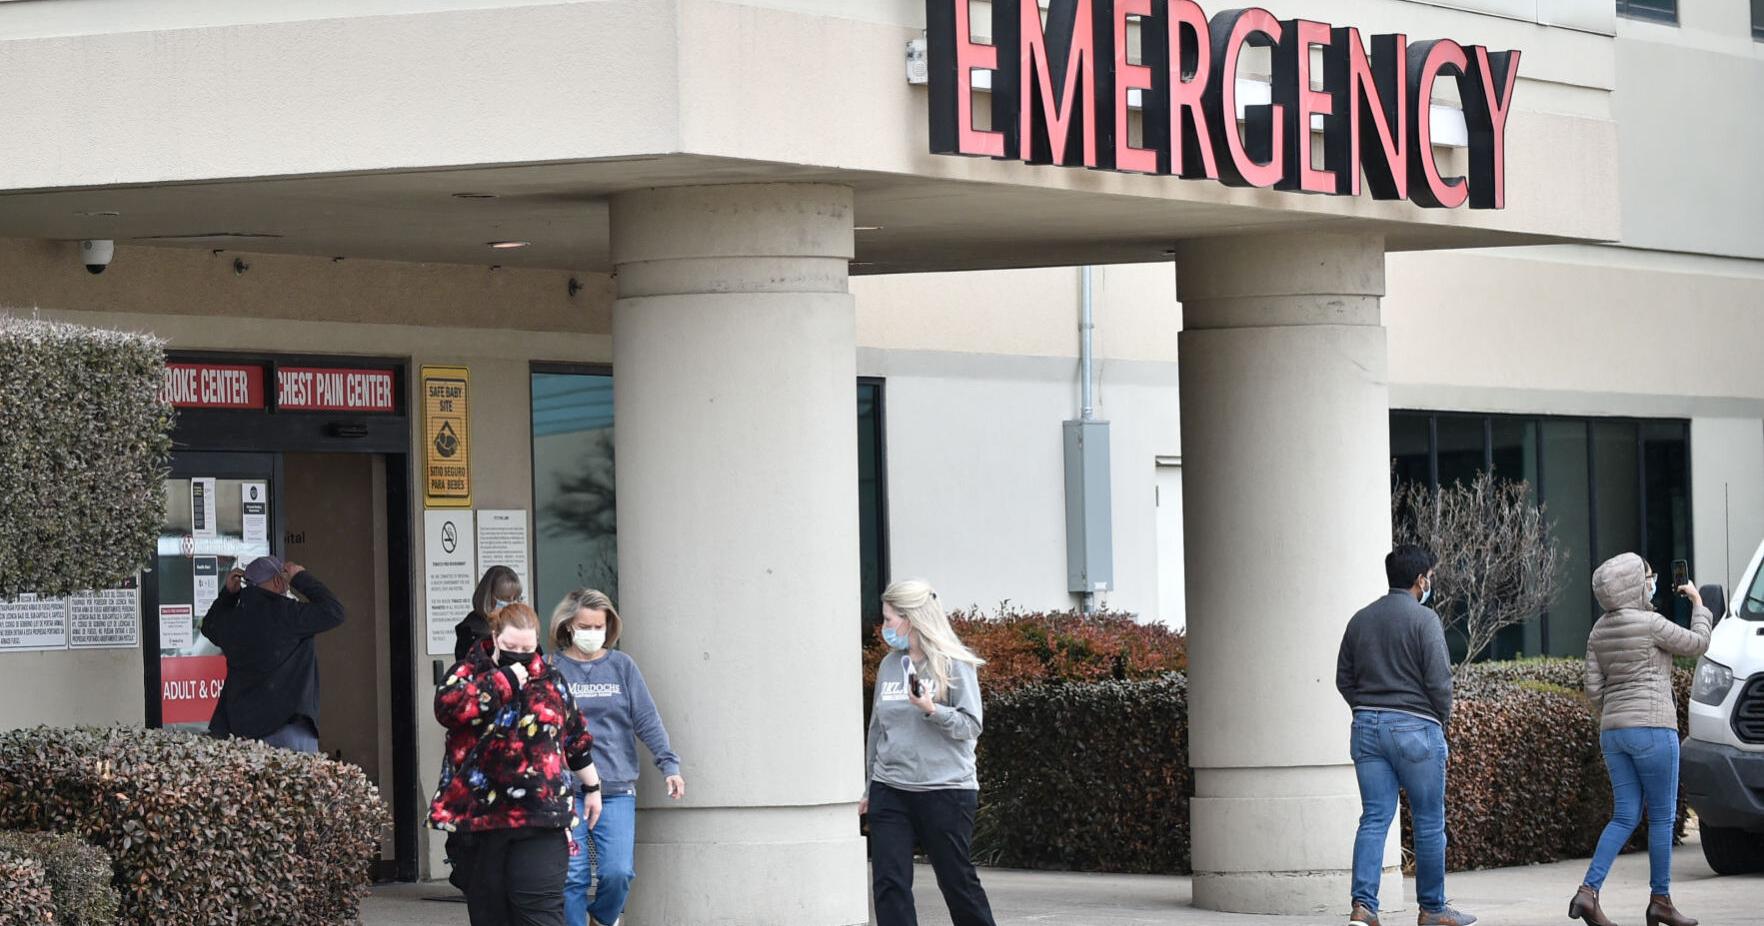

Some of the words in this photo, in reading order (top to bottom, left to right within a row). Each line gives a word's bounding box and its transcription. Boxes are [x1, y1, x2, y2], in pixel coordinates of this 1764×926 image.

[952, 0, 1521, 209] EMERGENCY
[201, 369, 248, 404] CENTER
[278, 370, 313, 406] CHEST
[316, 372, 344, 406] PAIN
[346, 374, 392, 408] CENTER
[429, 386, 444, 398] SAFE
[446, 386, 462, 398] BABY
[440, 400, 453, 412] SITE
[430, 466, 444, 477] SITIO
[444, 466, 466, 478] SEGURO
[431, 480, 445, 490] PARA
[164, 680, 196, 700] ADULT
[199, 680, 208, 699] &
